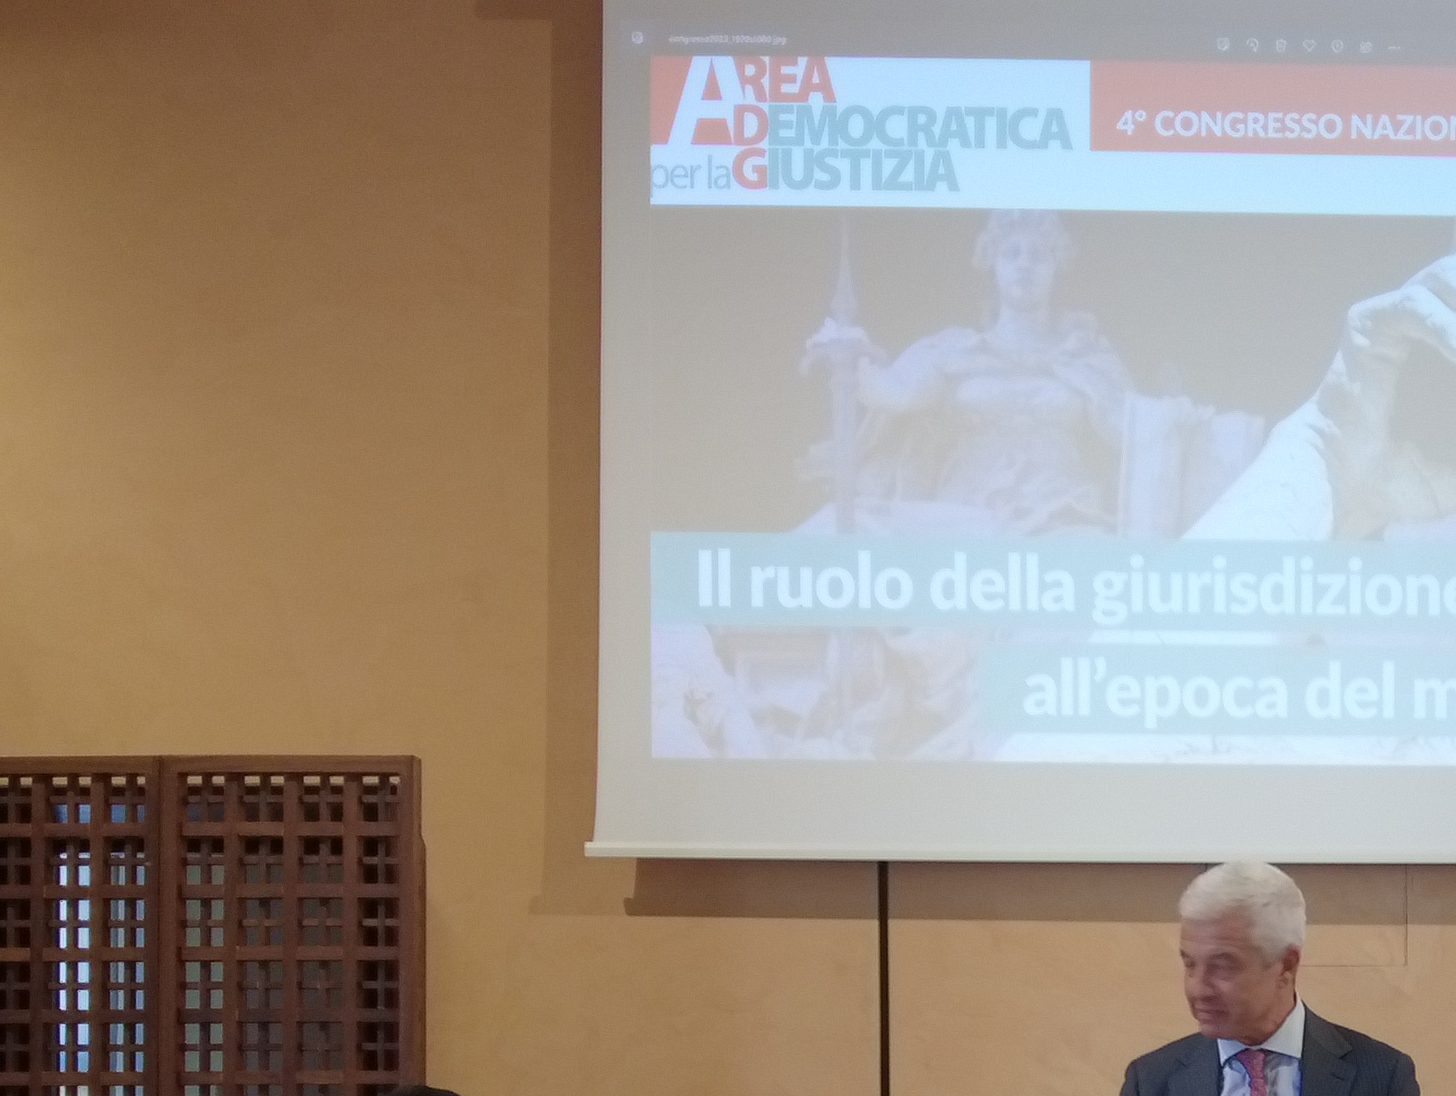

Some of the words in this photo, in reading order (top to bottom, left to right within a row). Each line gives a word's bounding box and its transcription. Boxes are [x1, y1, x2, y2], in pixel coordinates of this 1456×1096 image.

[667, 56, 837, 146] AREA
[733, 104, 1074, 150] DEMOCRATICA
[1116, 110, 1147, 135] 4°
[1154, 110, 1343, 139] CONGRESSO
[652, 164, 702, 197] per
[707, 154, 731, 189] la
[732, 147, 961, 192] GIUSTIZIA
[698, 548, 731, 607] Il
[750, 549, 914, 609] ruolo
[929, 551, 1075, 612] della
[1022, 656, 1289, 729] all'epoca
[1305, 660, 1395, 720] del
